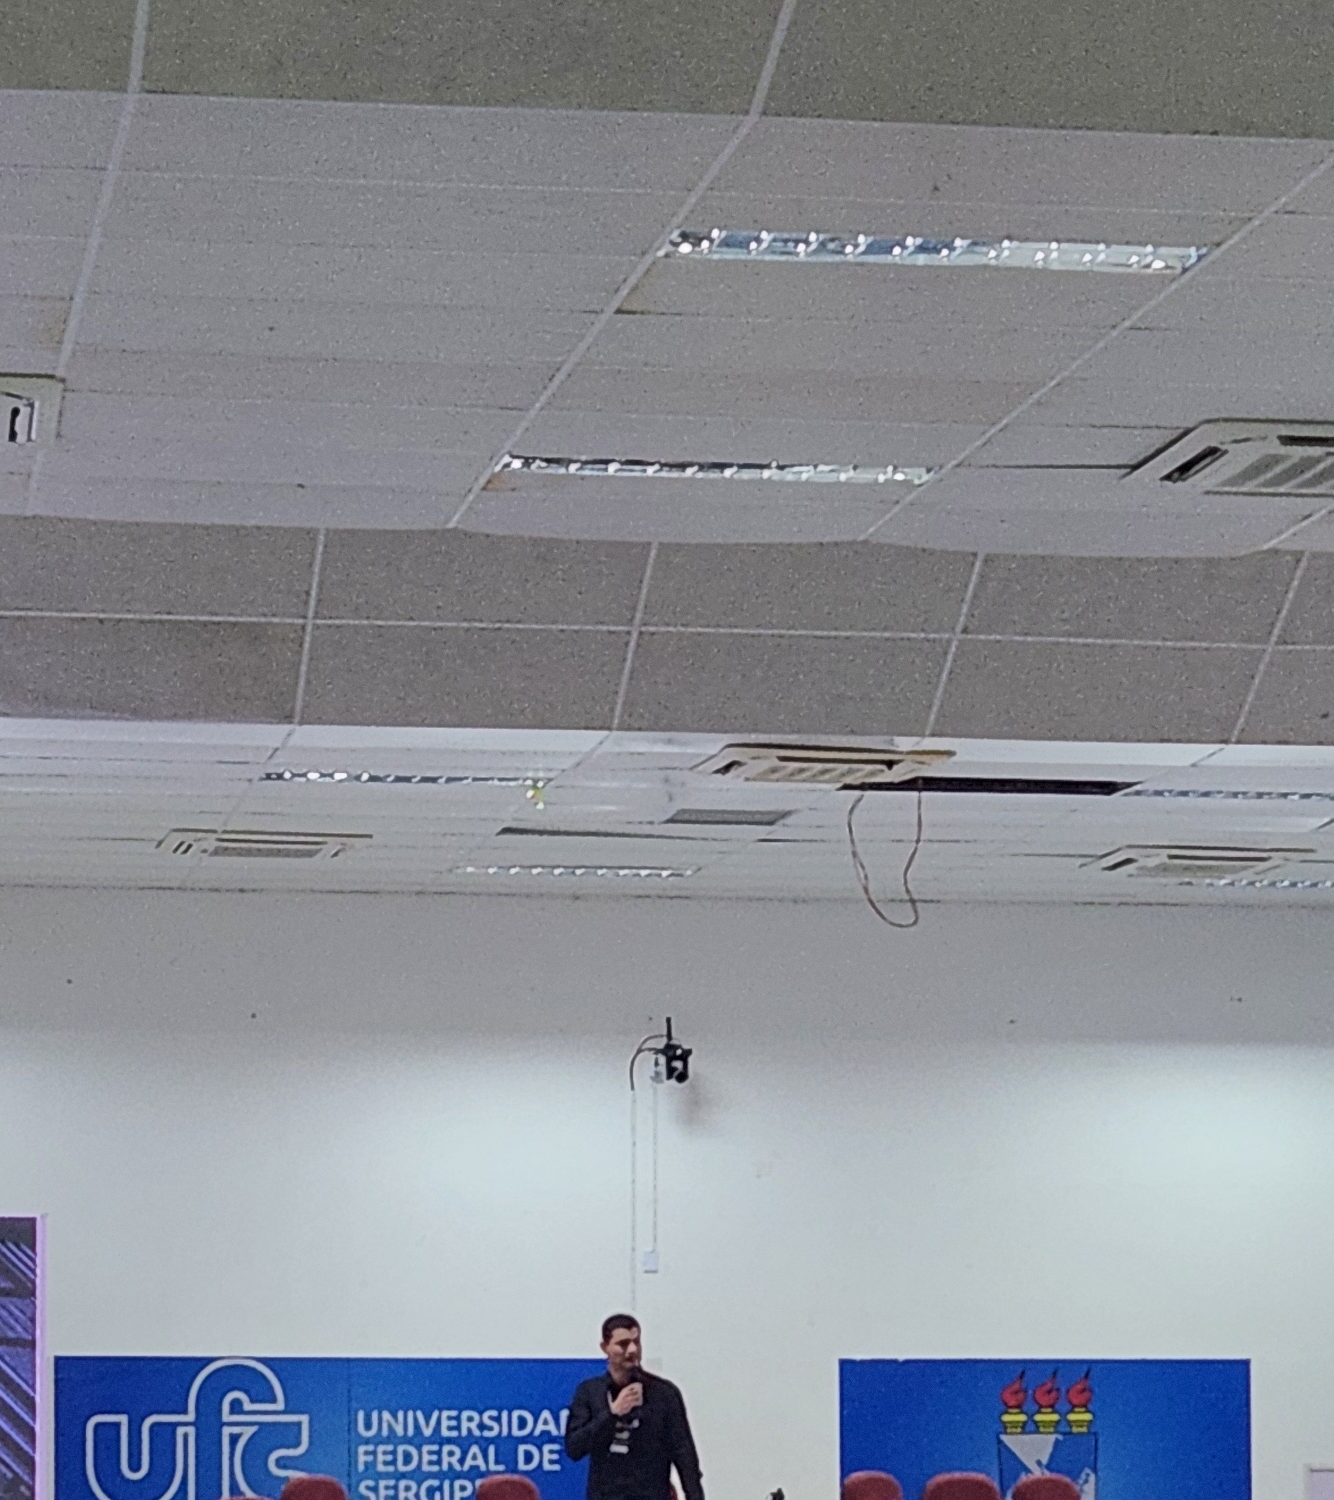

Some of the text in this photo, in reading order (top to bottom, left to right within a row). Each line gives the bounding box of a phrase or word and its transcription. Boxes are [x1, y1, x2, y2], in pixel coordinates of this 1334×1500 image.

[357, 1408, 569, 1438] UNIVERSIDA
[357, 1443, 561, 1473] FEDERAL DE
